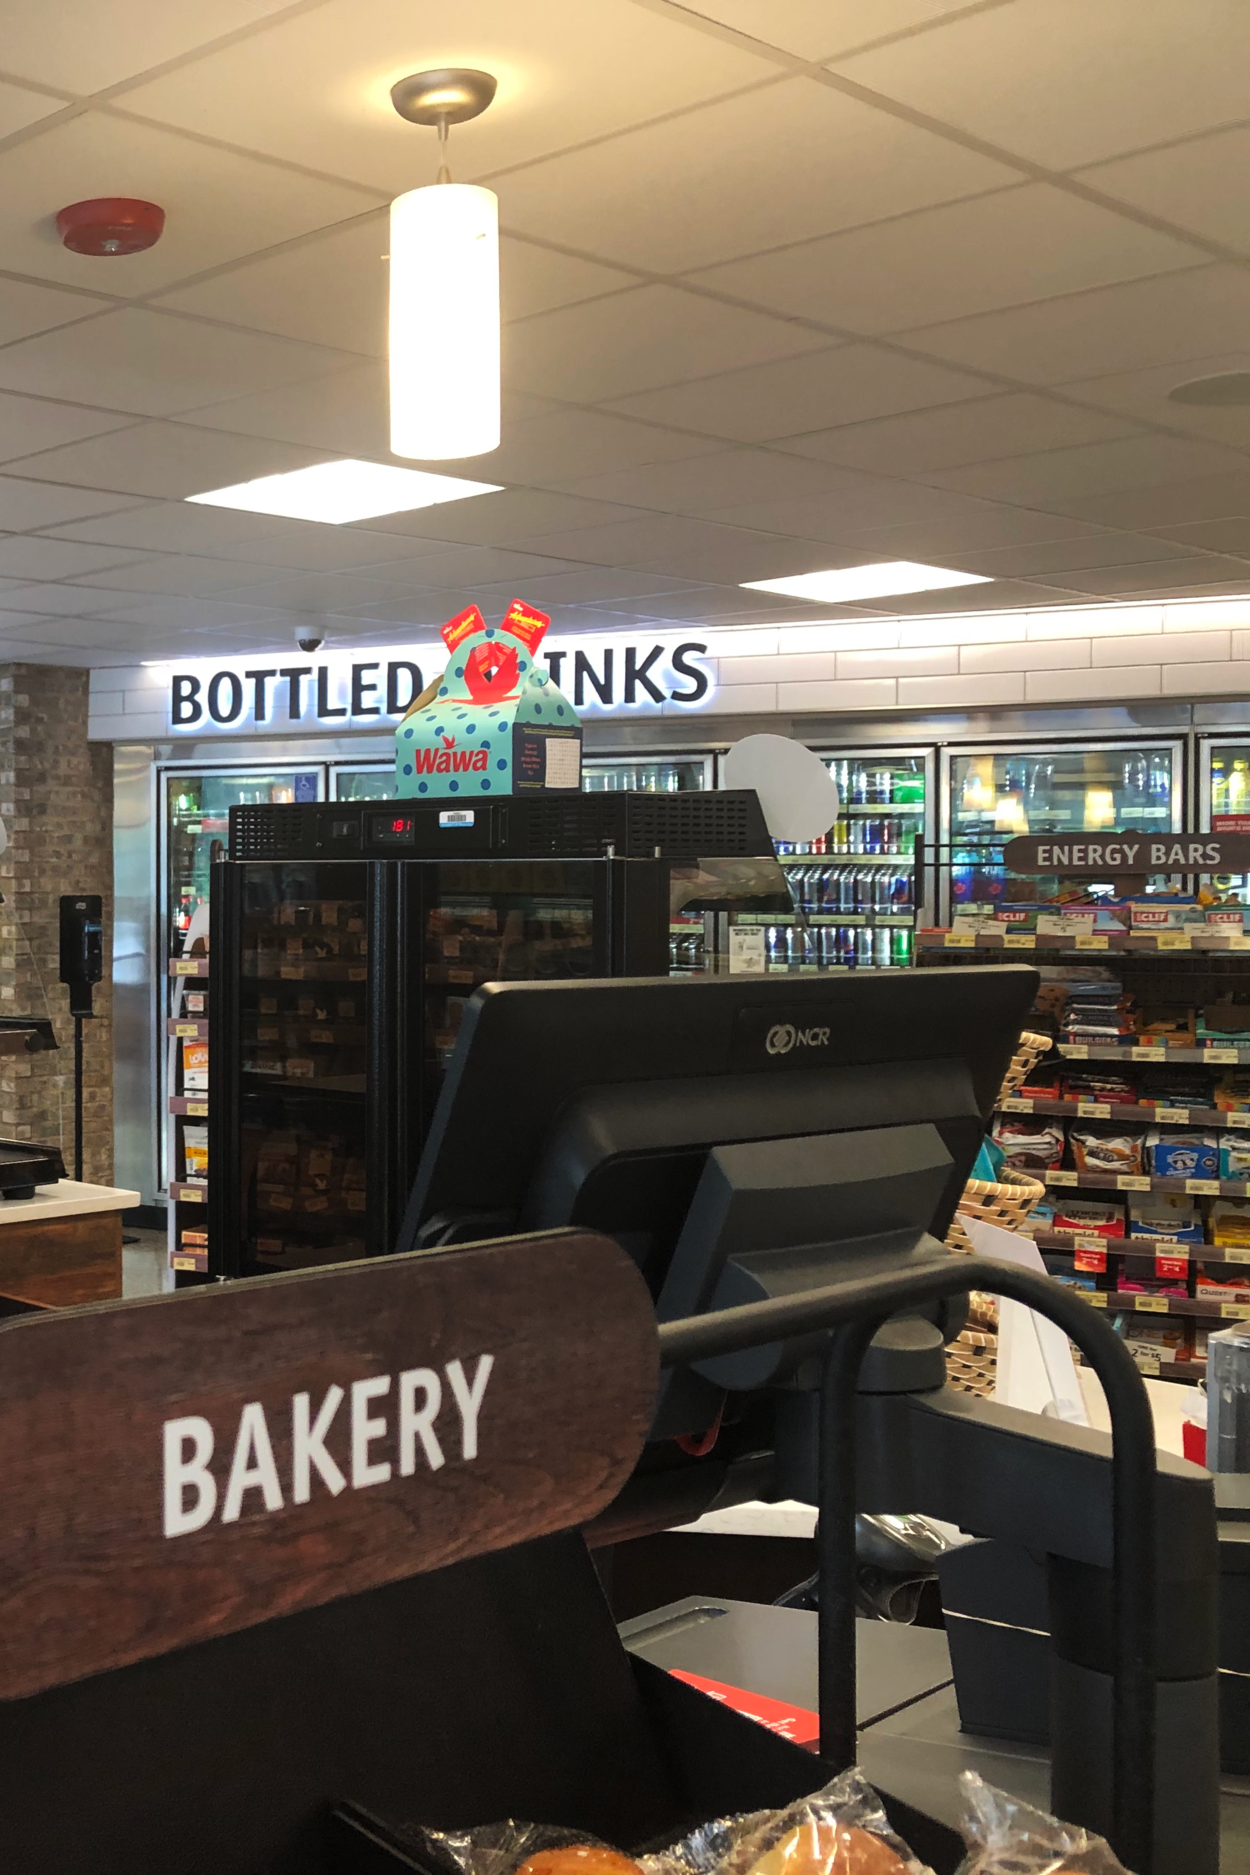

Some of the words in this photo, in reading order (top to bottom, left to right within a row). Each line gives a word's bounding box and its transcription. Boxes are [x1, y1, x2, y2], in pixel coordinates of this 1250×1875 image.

[171, 661, 423, 726] BOTTLED
[544, 642, 708, 707] INKS
[414, 746, 489, 775] Wawa
[1036, 844, 1140, 866] ENERGY
[1150, 843, 1221, 866] BARS
[1003, 912, 1026, 921] CLIF
[1142, 912, 1166, 921] CLIF
[1216, 914, 1242, 922] CLIF
[796, 1027, 830, 1046] NCR
[1200, 1288, 1227, 1296] QUEST
[1128, 1329, 1160, 1338] ONE
[162, 1354, 495, 1539] BAKERY
